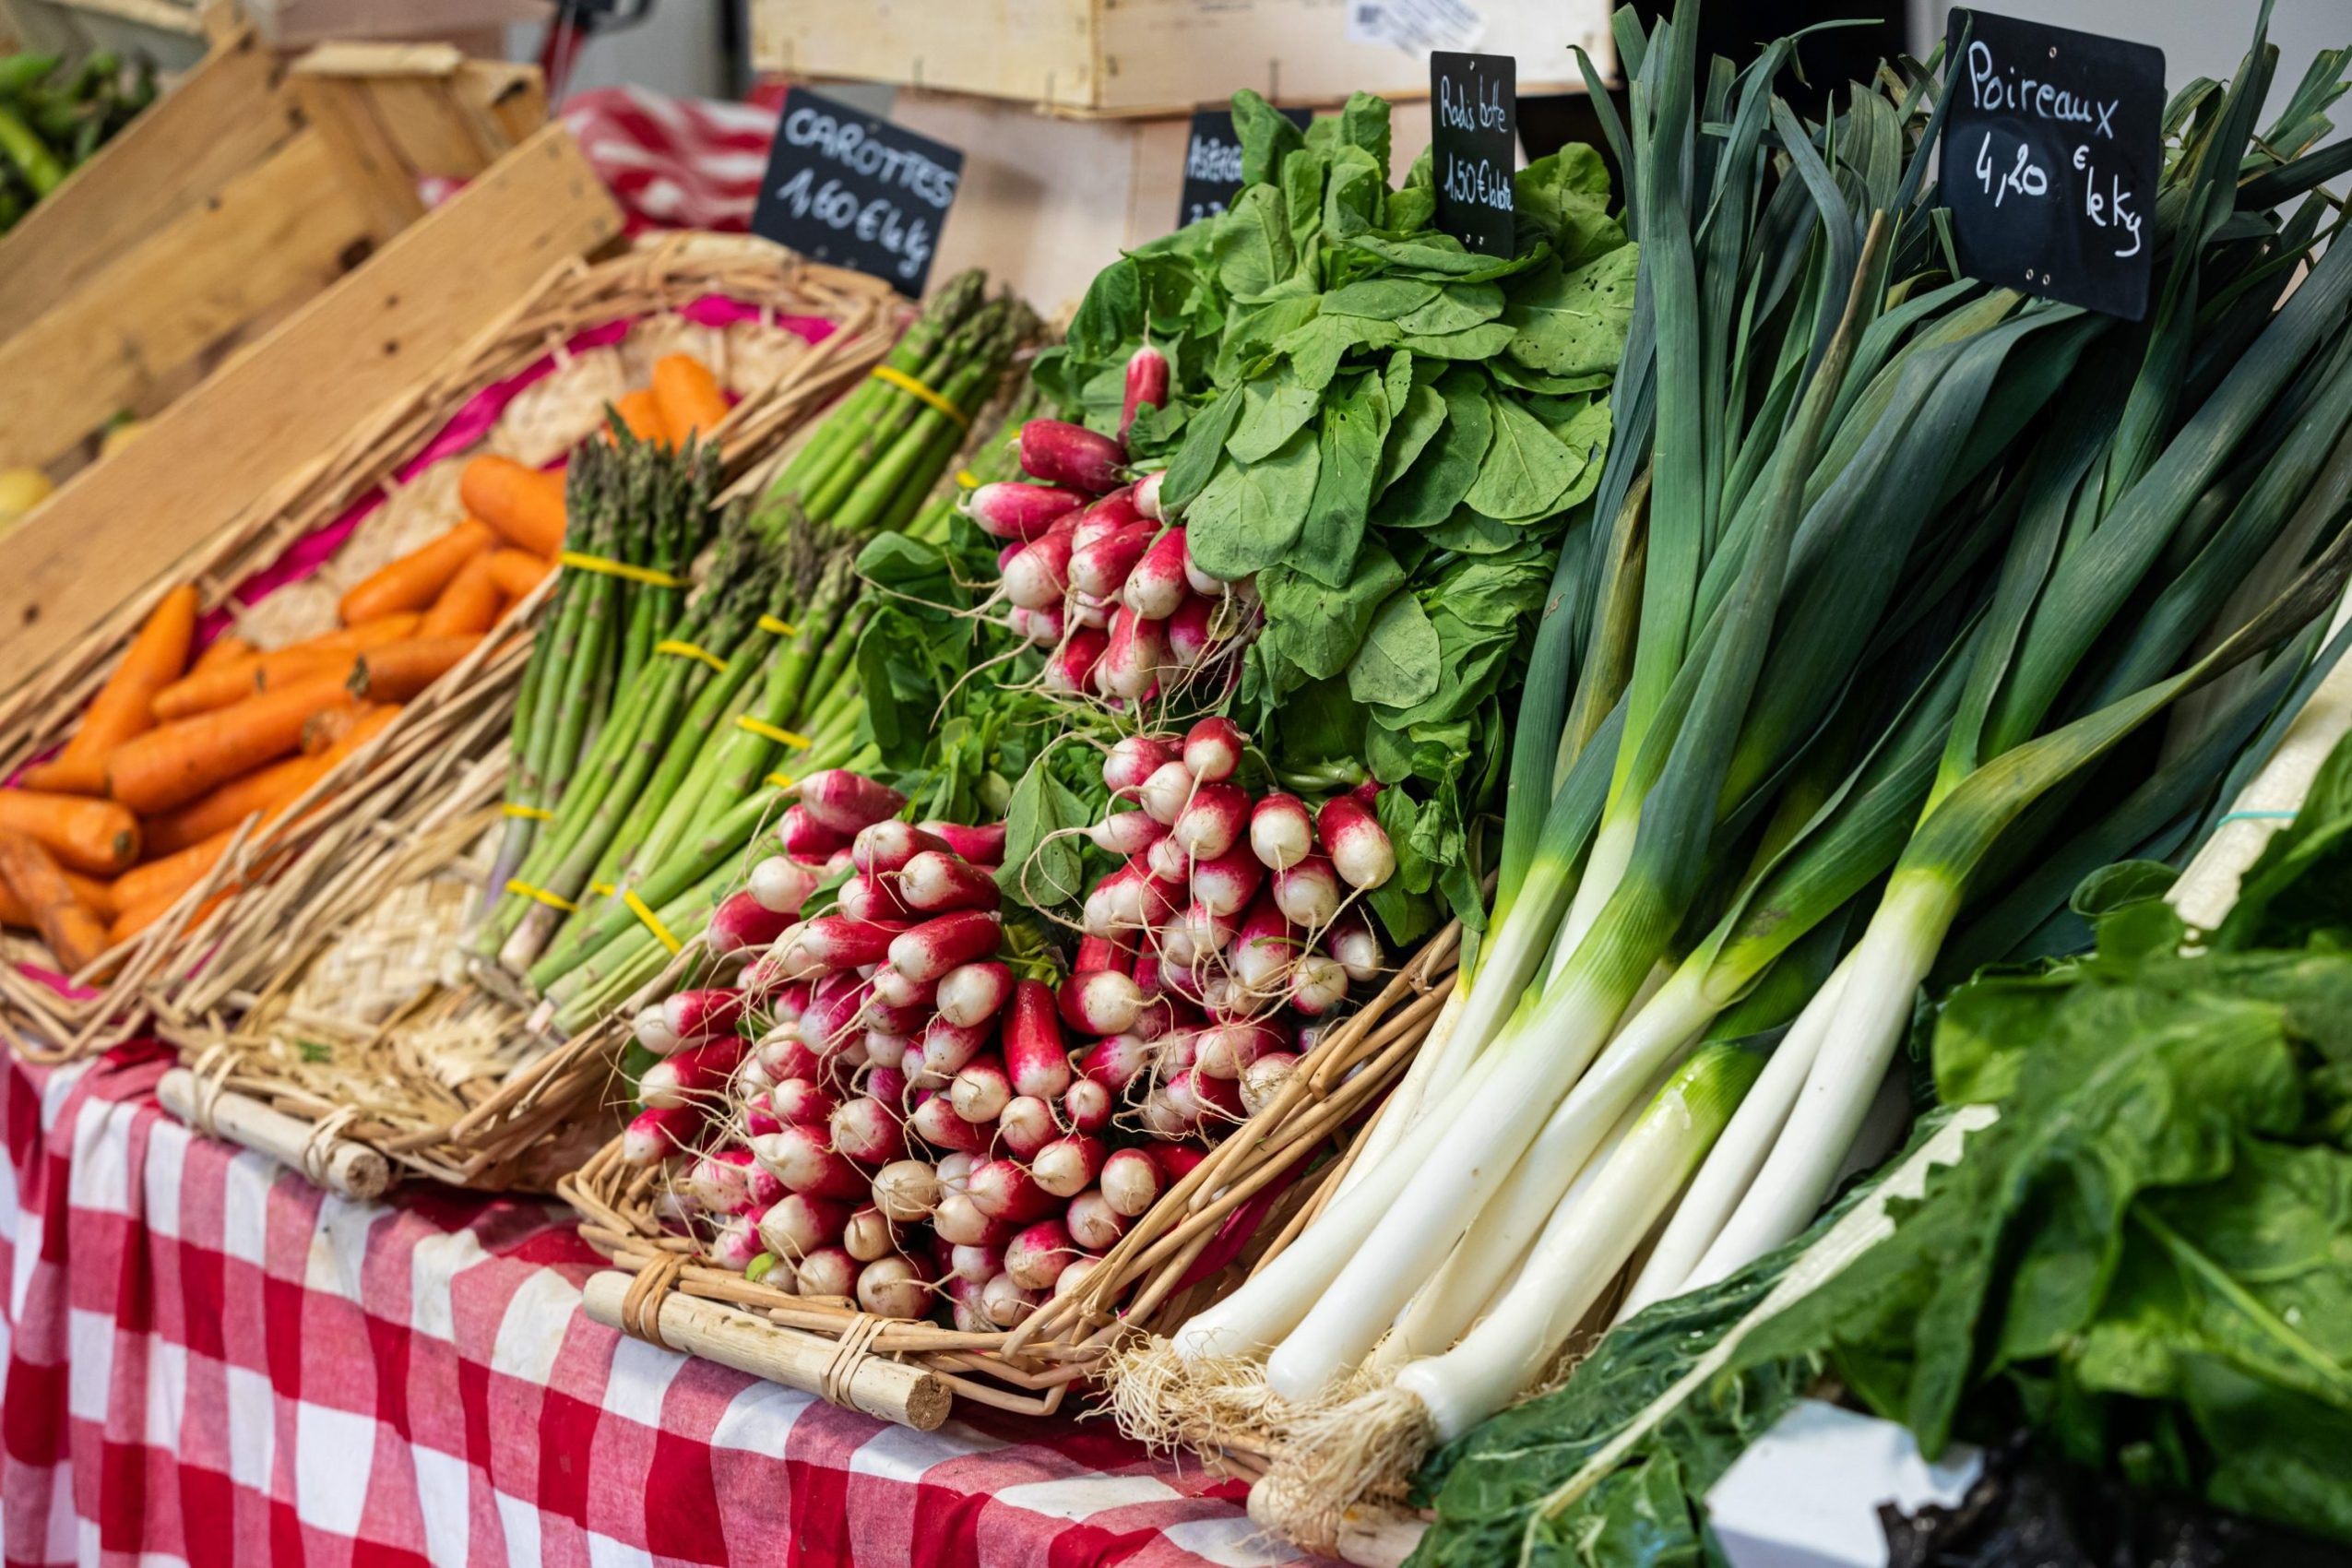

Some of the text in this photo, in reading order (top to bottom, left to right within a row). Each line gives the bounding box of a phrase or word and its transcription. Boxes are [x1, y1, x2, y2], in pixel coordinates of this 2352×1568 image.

[1441, 74, 1509, 134] Radis botte
[1968, 41, 2120, 139] Poireaux
[784, 107, 961, 209] CAROTTES
[1976, 131, 2049, 208] 4,20
[2086, 166, 2108, 228] le
